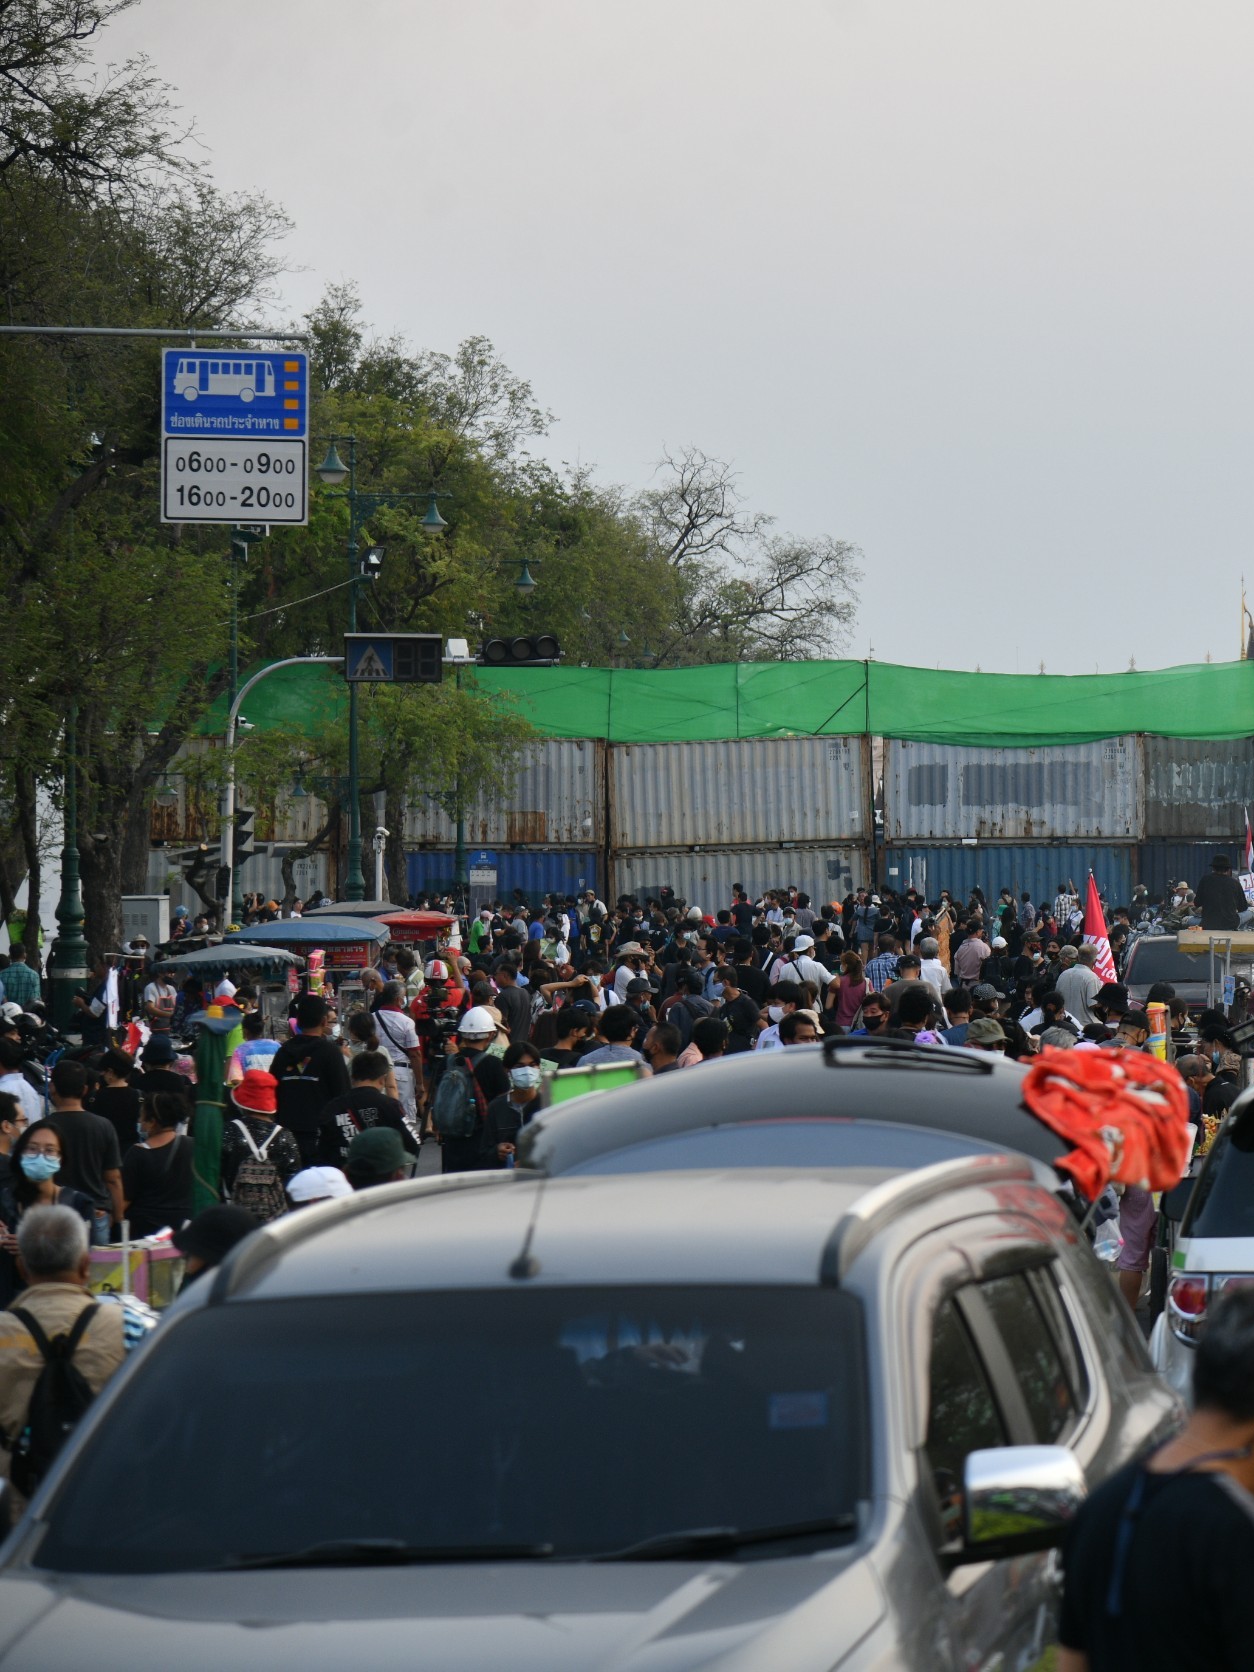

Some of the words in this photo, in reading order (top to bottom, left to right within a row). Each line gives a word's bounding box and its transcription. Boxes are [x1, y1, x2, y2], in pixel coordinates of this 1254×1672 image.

[170, 413, 280, 430] ช่องเดินรถประจำทาง
